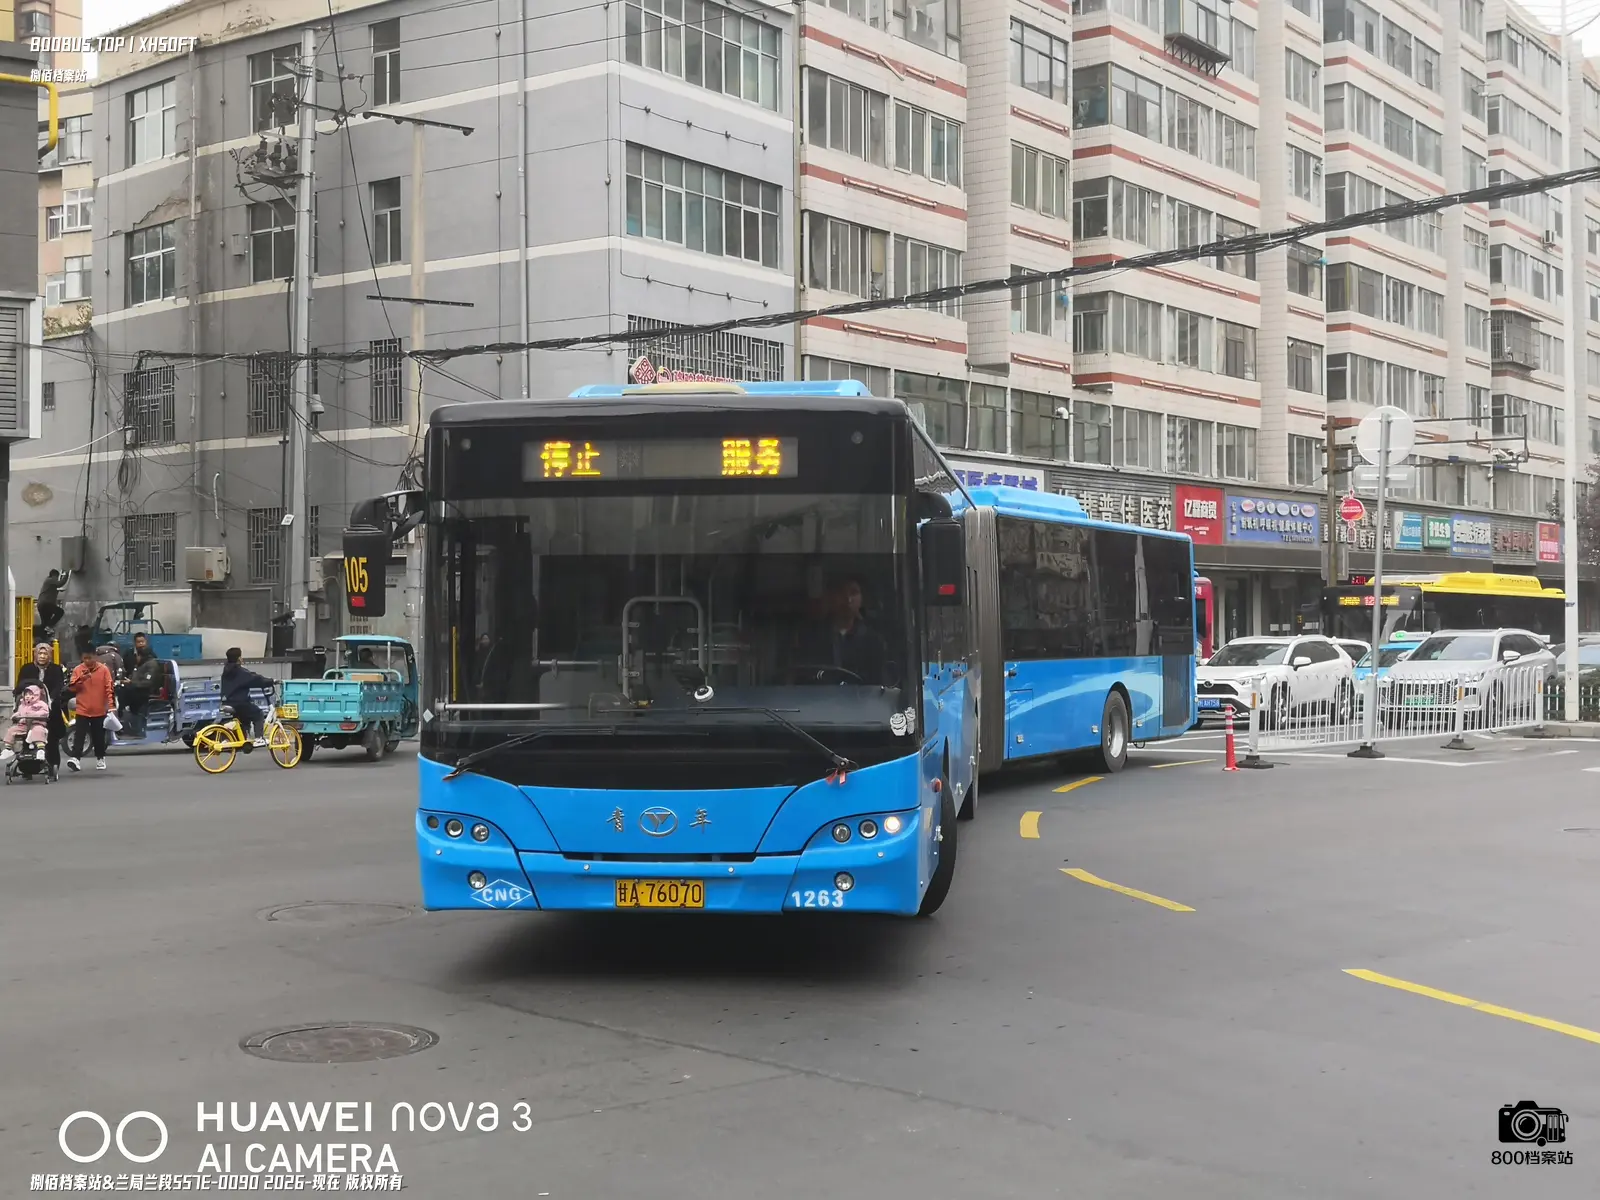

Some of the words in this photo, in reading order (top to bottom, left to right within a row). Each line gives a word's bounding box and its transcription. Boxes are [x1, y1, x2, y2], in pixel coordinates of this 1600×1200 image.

[540, 441, 601, 478] 停止
[1059, 489, 1172, 531] 肃普佳医药
[344, 556, 369, 593] 105
[482, 887, 521, 902] CNG
[792, 890, 844, 908] 1263
